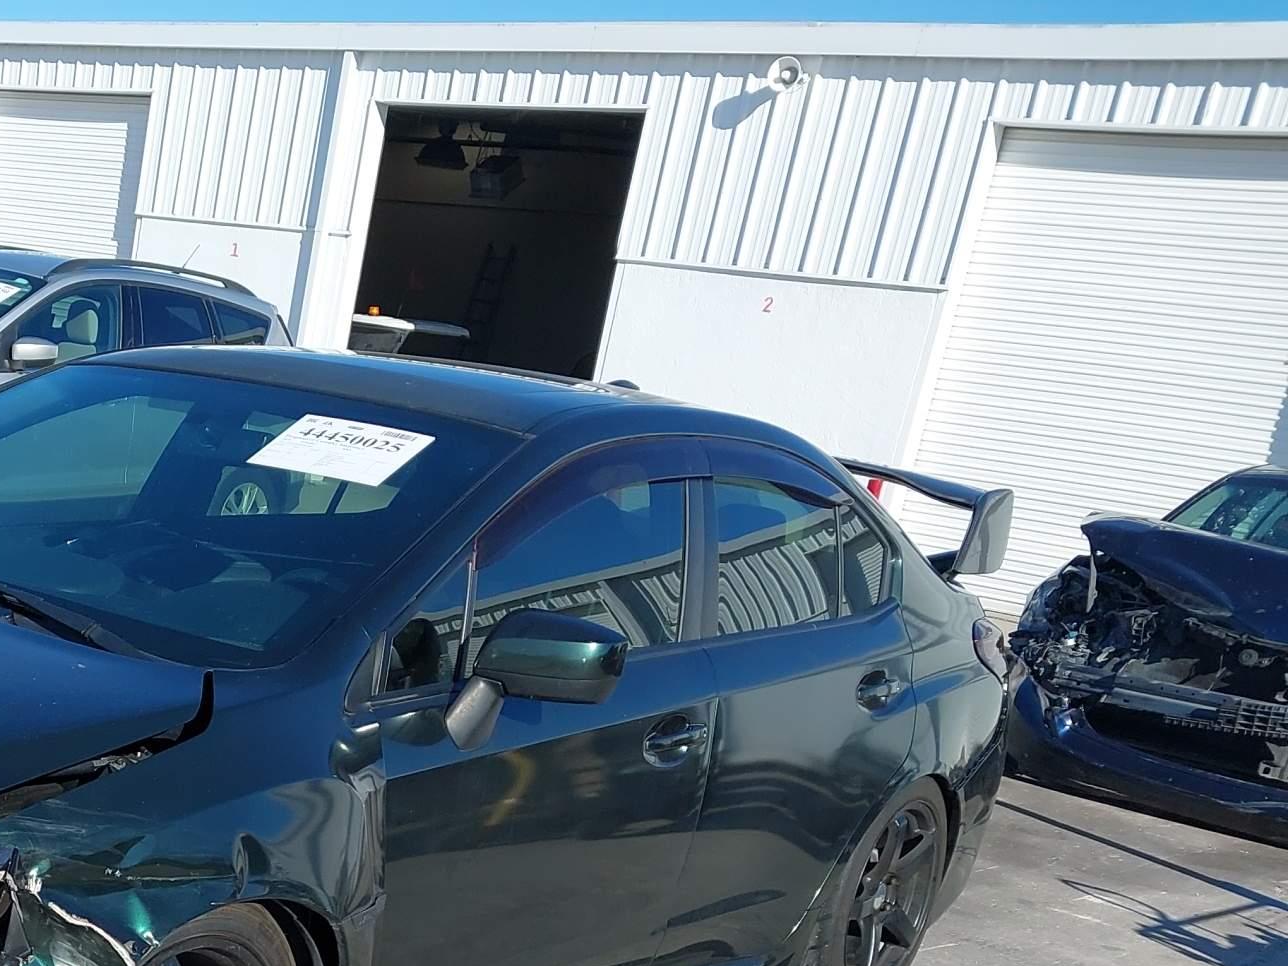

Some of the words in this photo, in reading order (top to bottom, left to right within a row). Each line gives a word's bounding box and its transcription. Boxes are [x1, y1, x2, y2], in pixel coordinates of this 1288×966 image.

[229, 242, 240, 258] 1
[762, 296, 774, 313] 2
[299, 427, 405, 453] 44450025
